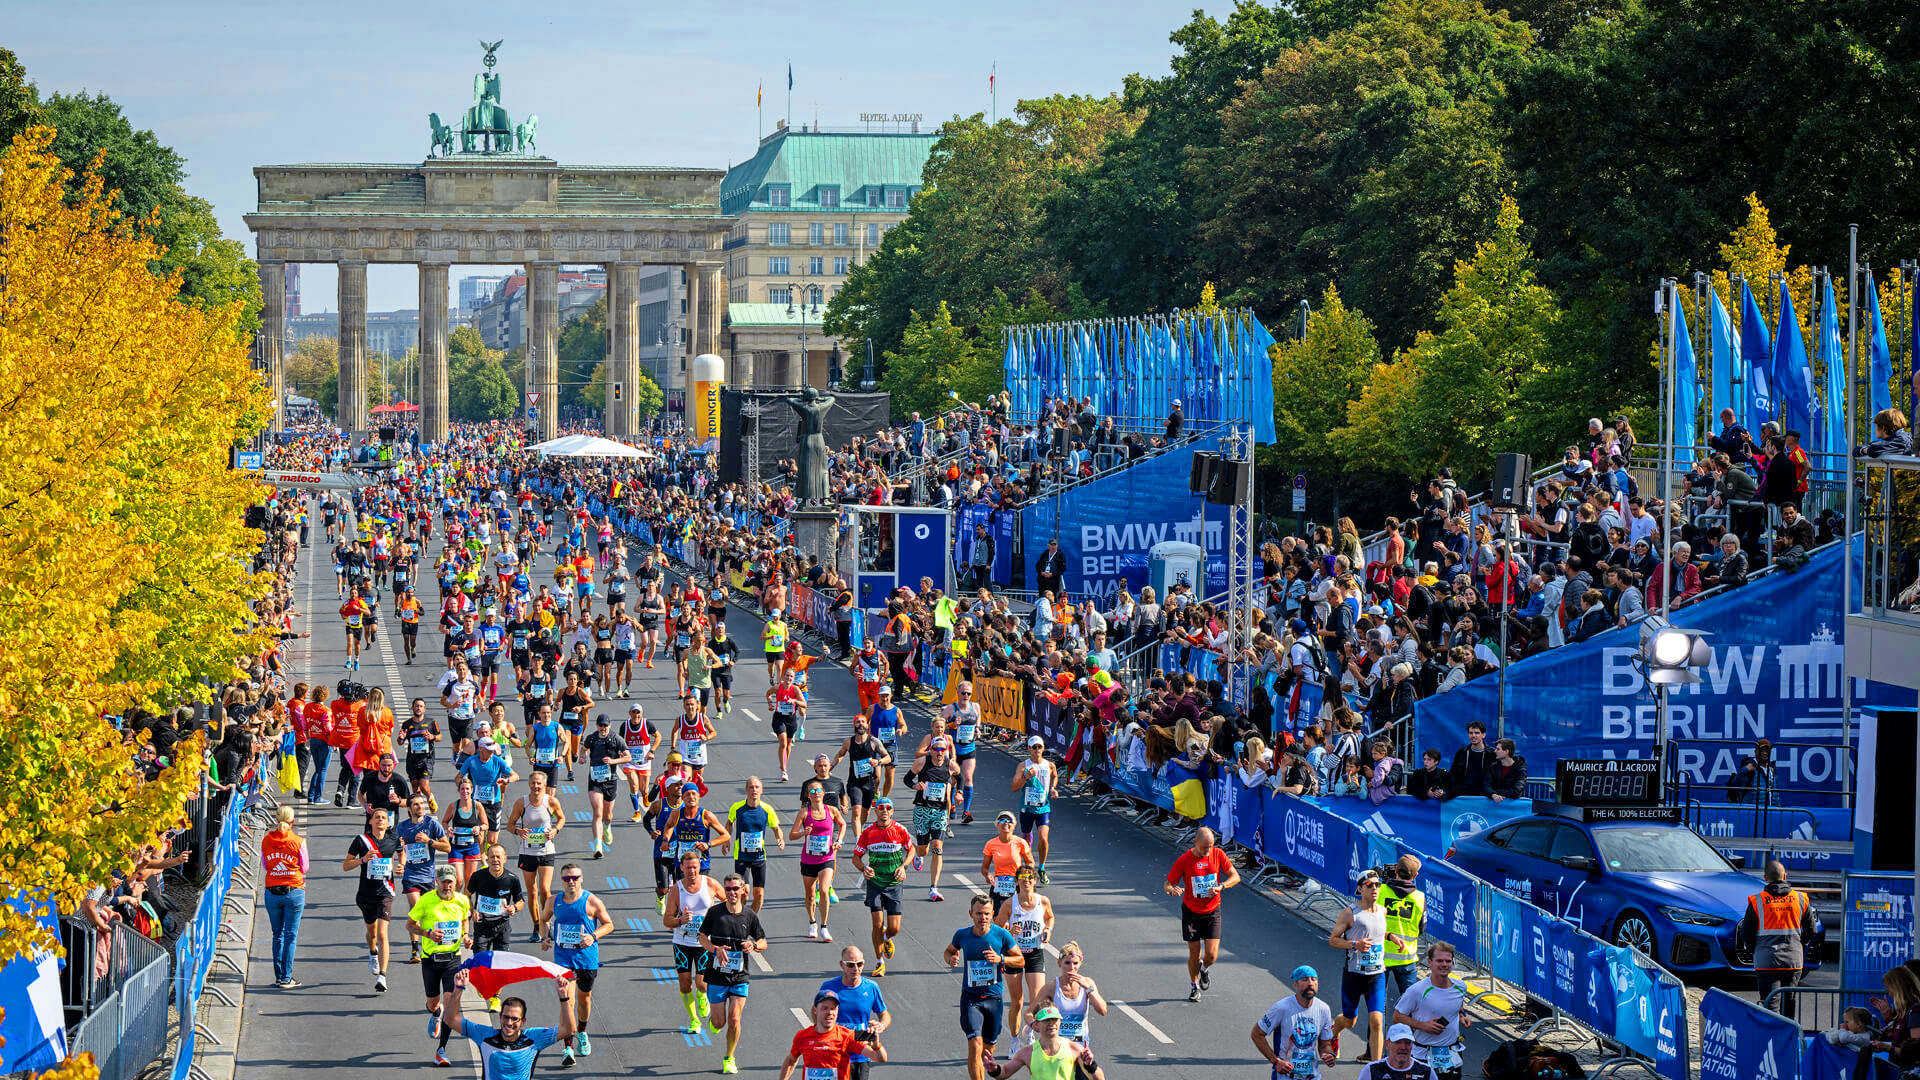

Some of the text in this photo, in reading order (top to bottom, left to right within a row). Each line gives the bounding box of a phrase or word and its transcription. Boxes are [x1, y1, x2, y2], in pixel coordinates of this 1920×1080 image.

[860, 113, 922, 122] HOTEL ADLON
[708, 389, 717, 438] ERDINGER
[279, 474, 321, 484] mateco
[1081, 523, 1168, 552] BMW
[1602, 703, 1766, 740] BERLIN
[1566, 761, 1657, 772] MAURICE LACROIX
[1456, 814, 1485, 825] BMW
[1592, 810, 1607, 818] THE
[1618, 810, 1638, 818] 100%
[1297, 813, 1324, 848] 万达体育
[267, 852, 294, 862] BERLIN
[1297, 844, 1325, 869] WANDA SPORTS
[1505, 878, 1522, 890] BMW
[1542, 891, 1554, 901] THE
[1704, 1019, 1727, 1043] MW
[1656, 1039, 1677, 1057] Abbott
[1703, 1042, 1725, 1059] RLIN
[1701, 1055, 1737, 1080] RATHON
